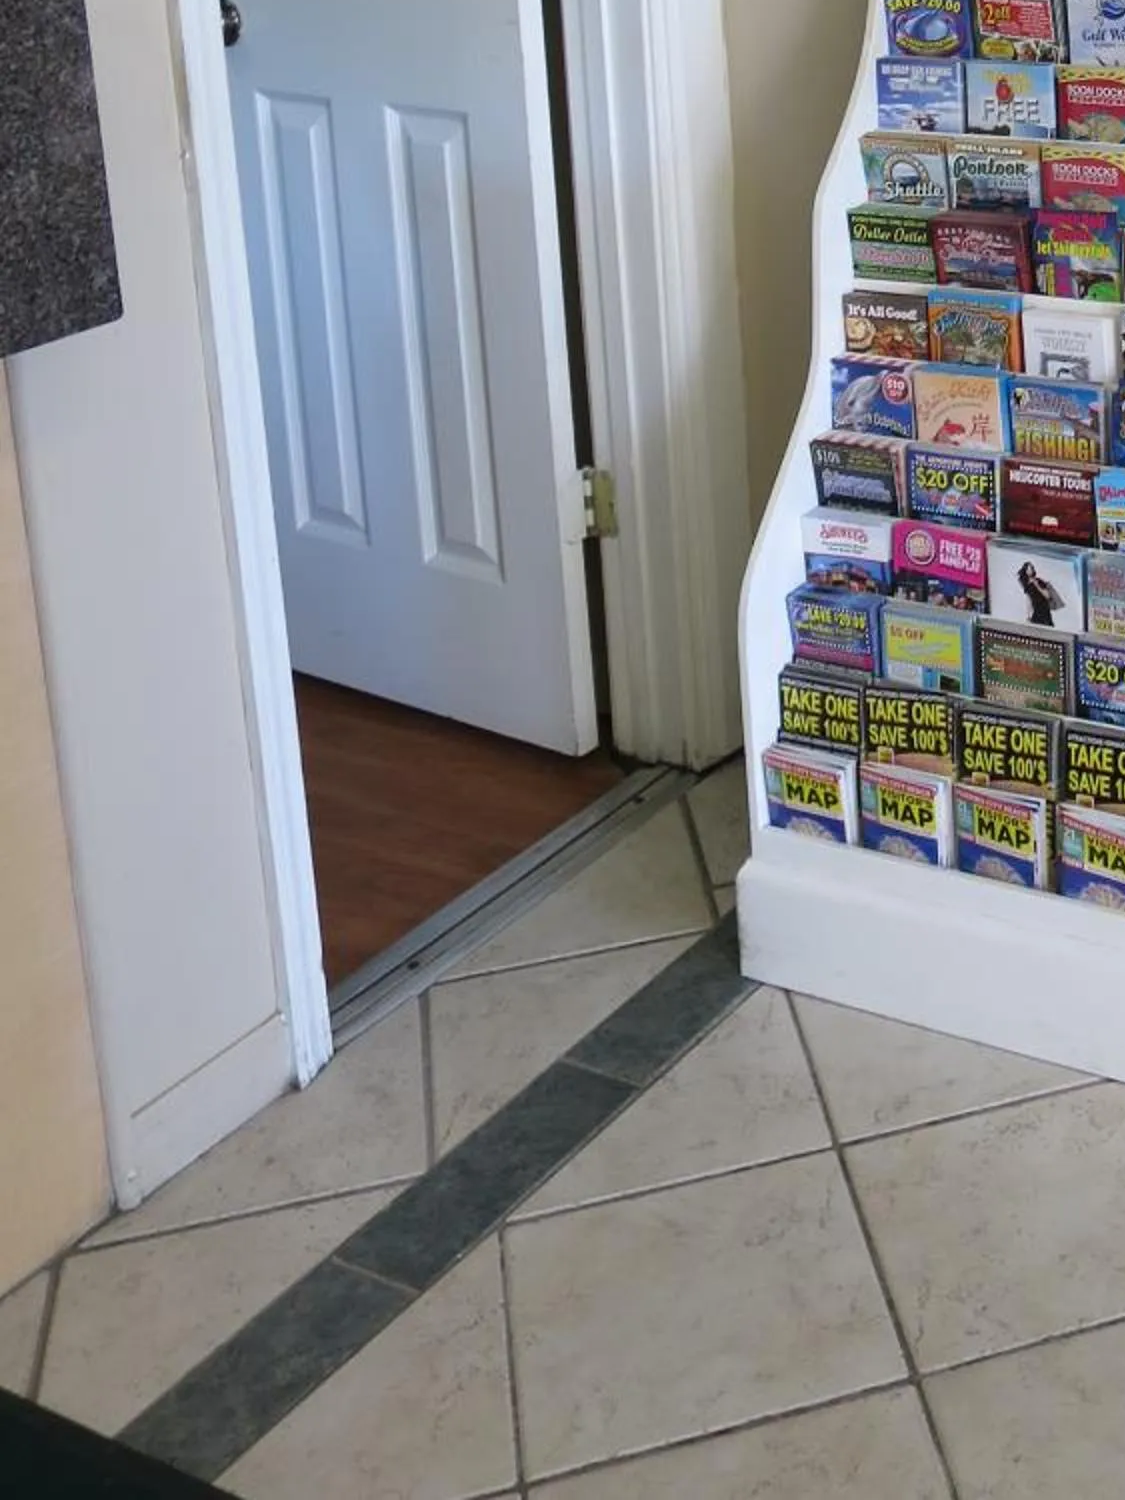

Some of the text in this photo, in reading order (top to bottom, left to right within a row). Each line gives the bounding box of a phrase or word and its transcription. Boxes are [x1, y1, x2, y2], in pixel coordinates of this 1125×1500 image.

[1015, 429, 1096, 462] FISHING!
[916, 467, 948, 489] $20
[953, 472, 989, 494] OFF
[1085, 660, 1119, 684] $20
[782, 685, 858, 717] TAKE ONE
[866, 699, 947, 725] TAKE ONE
[784, 712, 820, 735] SAVE
[869, 729, 908, 748] SAVE
[962, 722, 1046, 756] TAKE ONE
[964, 749, 1005, 775] SAVE
[1068, 743, 1113, 773] TAKE
[786, 782, 839, 809] MAP
[1069, 769, 1111, 797] SAVE
[880, 799, 933, 829] MAP
[978, 819, 1030, 849] MAP
